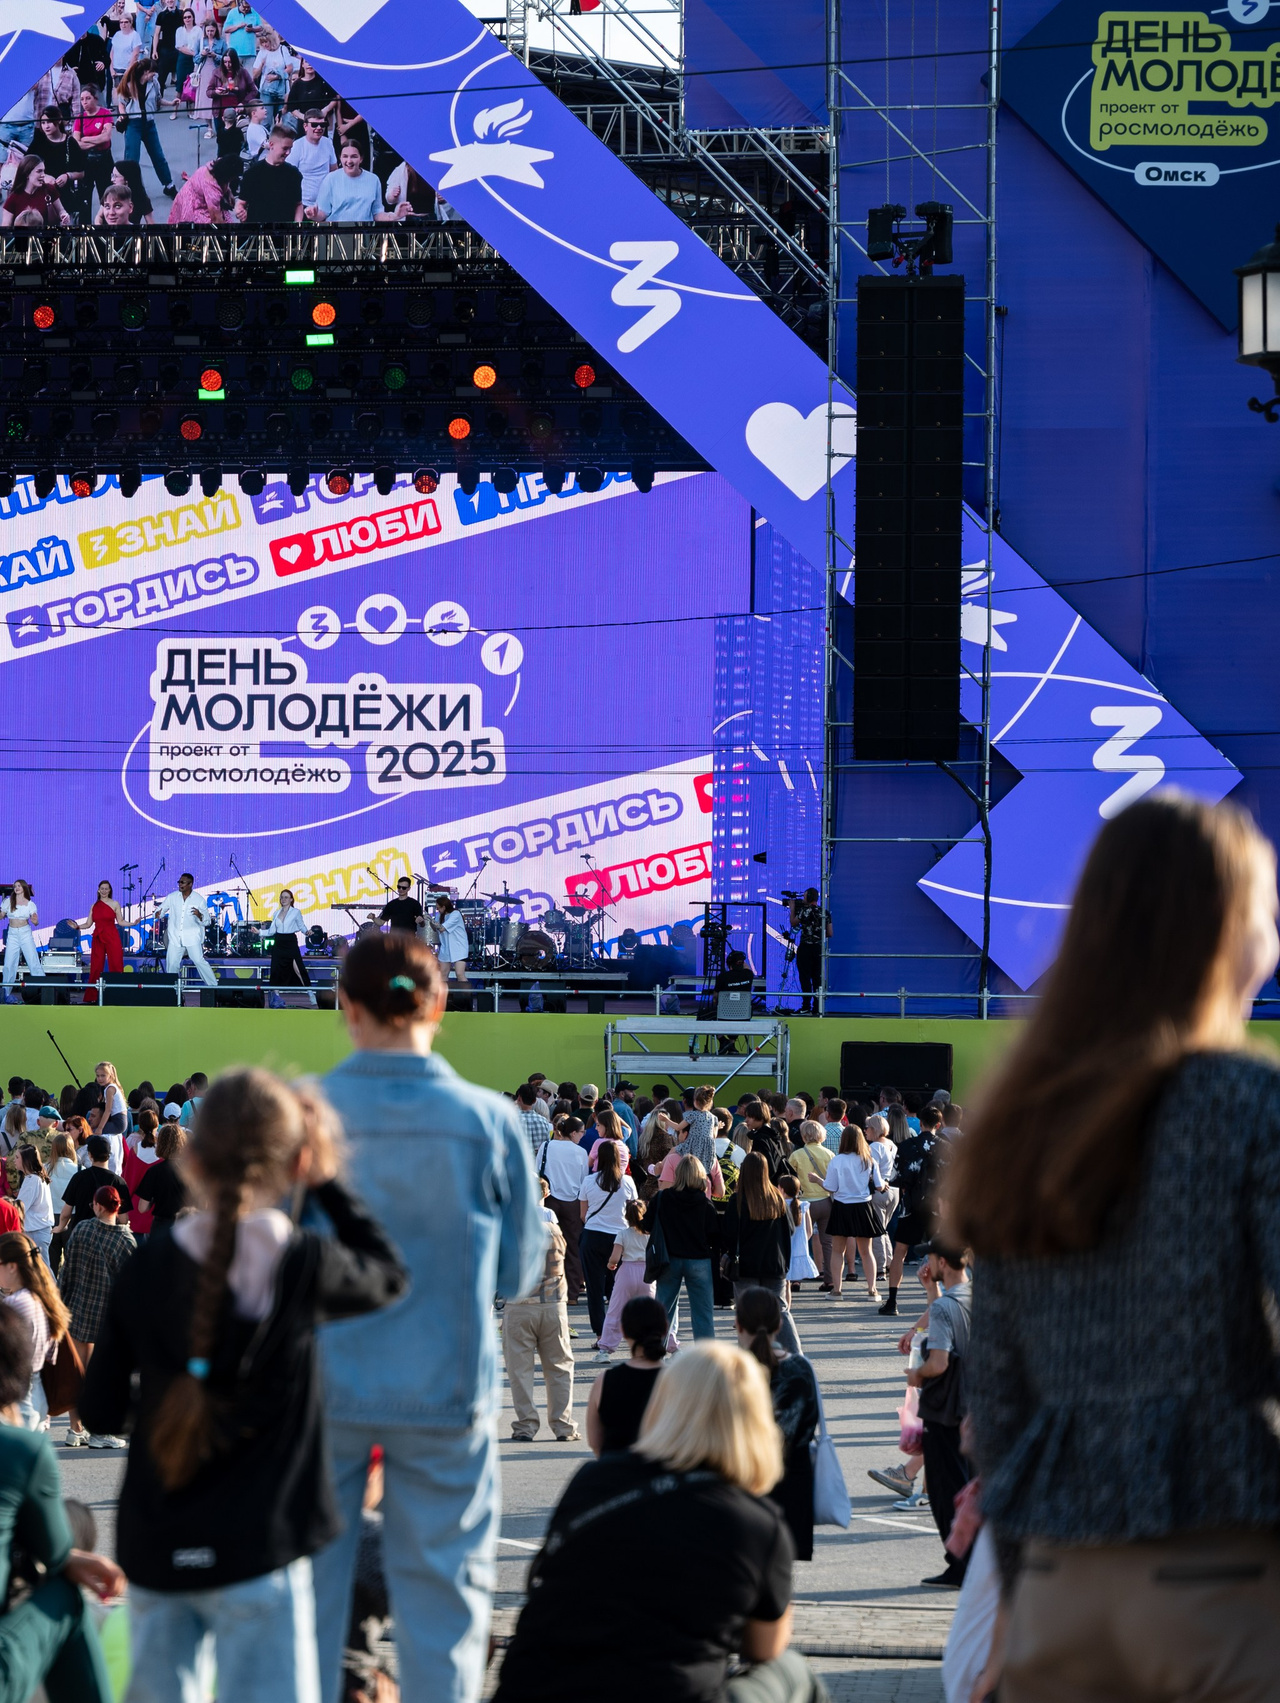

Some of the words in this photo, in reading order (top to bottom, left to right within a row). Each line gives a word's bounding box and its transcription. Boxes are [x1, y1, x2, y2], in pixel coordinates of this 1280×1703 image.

[1101, 20, 1222, 58] ДЕНЬ
[1099, 103, 1156, 116] проект
[1161, 104, 1180, 114] от
[1099, 120, 1260, 142] росмолодёжь
[1145, 166, 1207, 182] Омск
[116, 496, 237, 554] ЗНАЙ
[311, 502, 439, 562] ЛЮБИ
[46, 554, 255, 634] ГОРДИСЬ
[160, 648, 297, 693] ДЕНЬ
[160, 683, 471, 738] МОЛОДЁЖИ
[159, 743, 221, 759] проект
[229, 744, 250, 757] от
[375, 737, 497, 784] 2025
[159, 763, 342, 790] росмолодёжь
[464, 792, 680, 869] ГОРДИСЬ
[291, 851, 410, 911] ЗНАЙ
